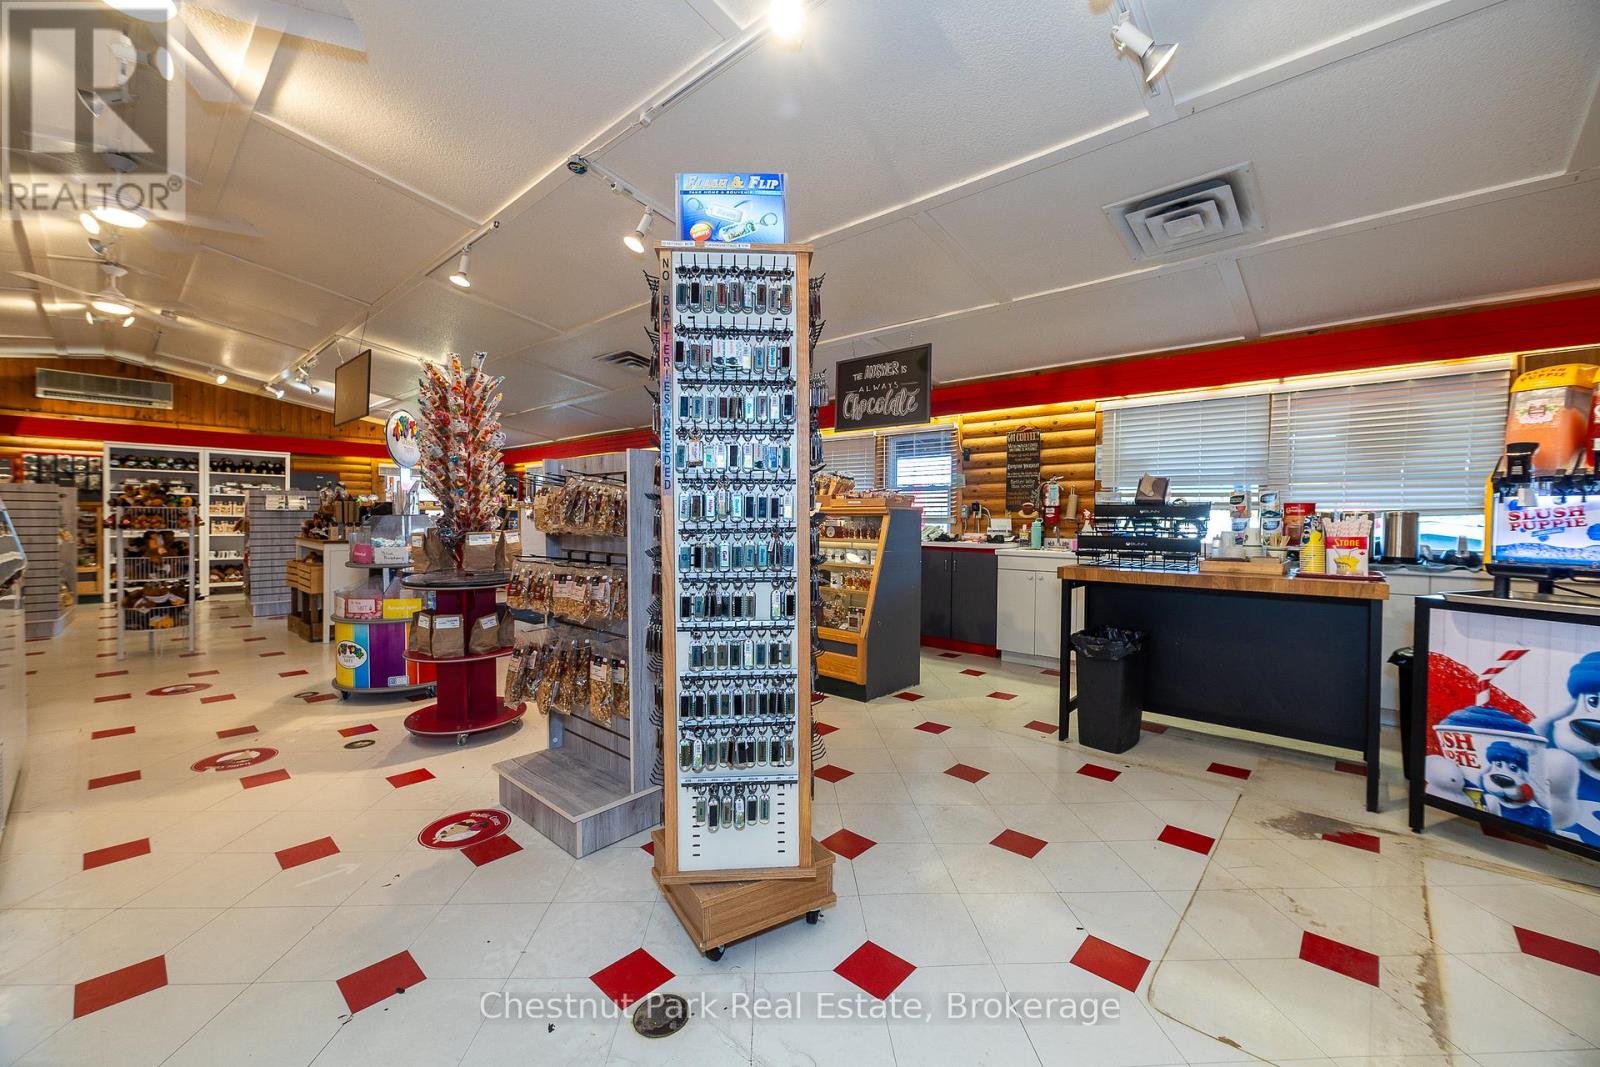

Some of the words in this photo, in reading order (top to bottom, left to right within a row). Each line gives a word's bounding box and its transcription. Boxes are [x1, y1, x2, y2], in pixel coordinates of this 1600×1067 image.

[749, 175, 779, 190] FLIP
[662, 258, 670, 281] NO
[662, 295, 671, 404] BATTERIES
[864, 361, 899, 379] ANSWER
[901, 365, 908, 374] IS
[859, 381, 899, 393] ALWAYS
[843, 387, 920, 421] Chocolate
[1508, 506, 1586, 521] SLUSH
[1334, 538, 1360, 547] STONE
